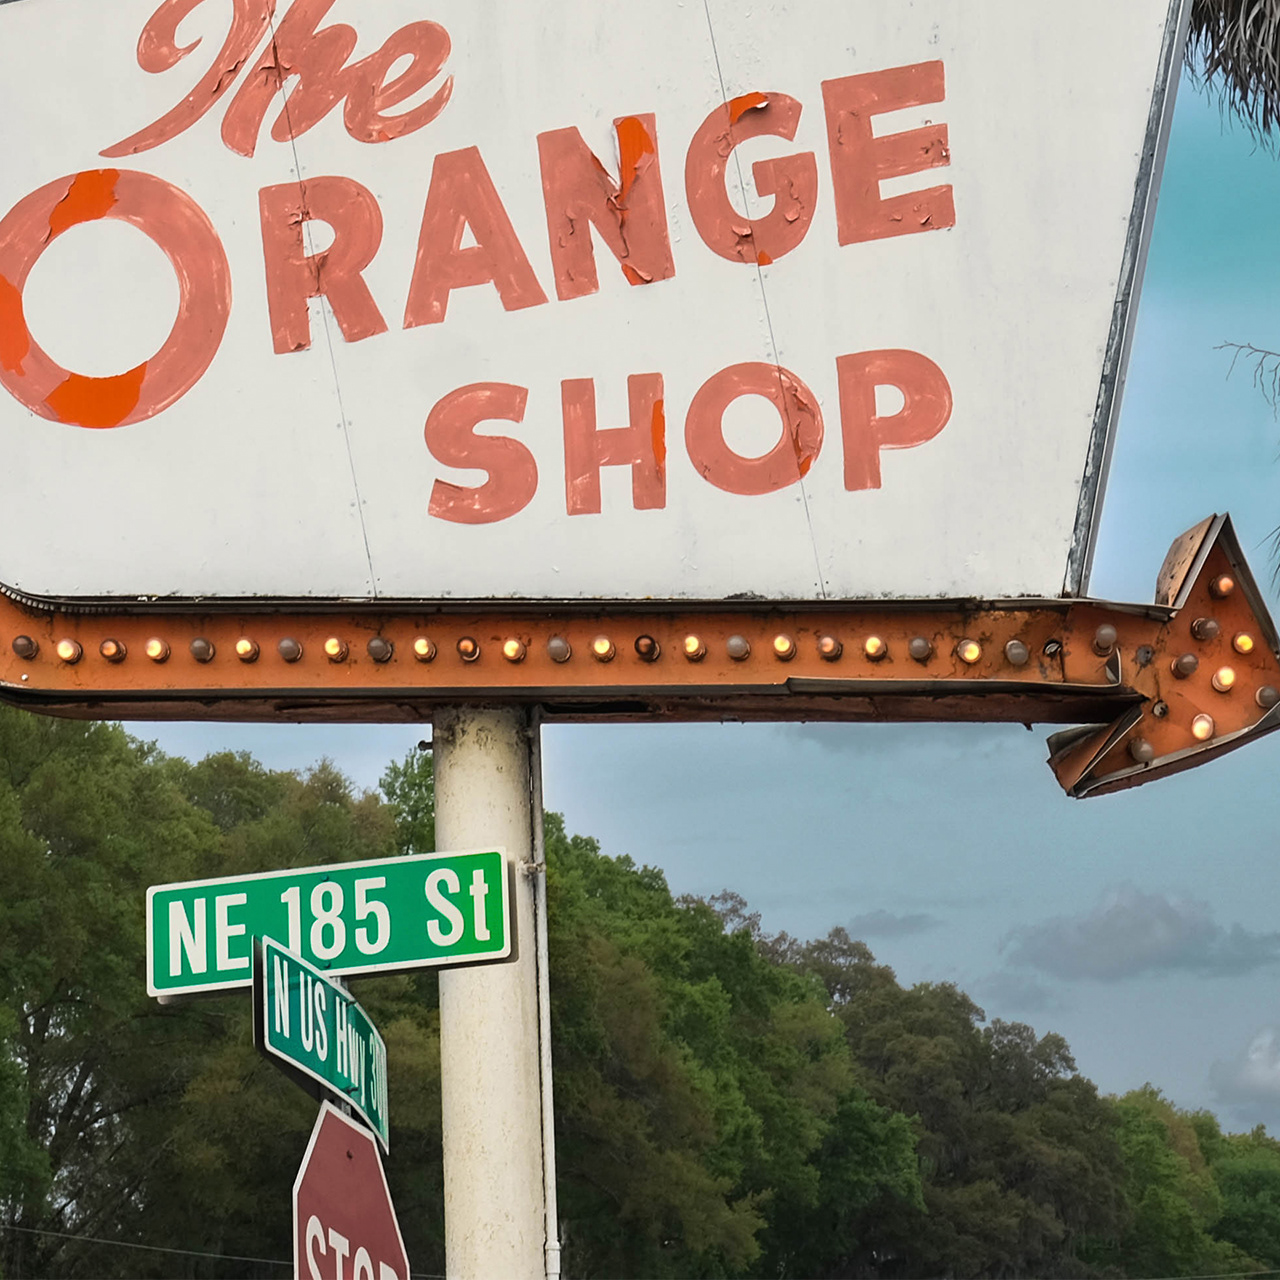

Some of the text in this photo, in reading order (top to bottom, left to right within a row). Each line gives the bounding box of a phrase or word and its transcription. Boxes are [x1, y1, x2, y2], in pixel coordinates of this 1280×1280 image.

[423, 348, 953, 524] SHOP
[168, 868, 491, 977] NE 185 St
[273, 954, 290, 1038] N
[299, 971, 328, 1062] US
